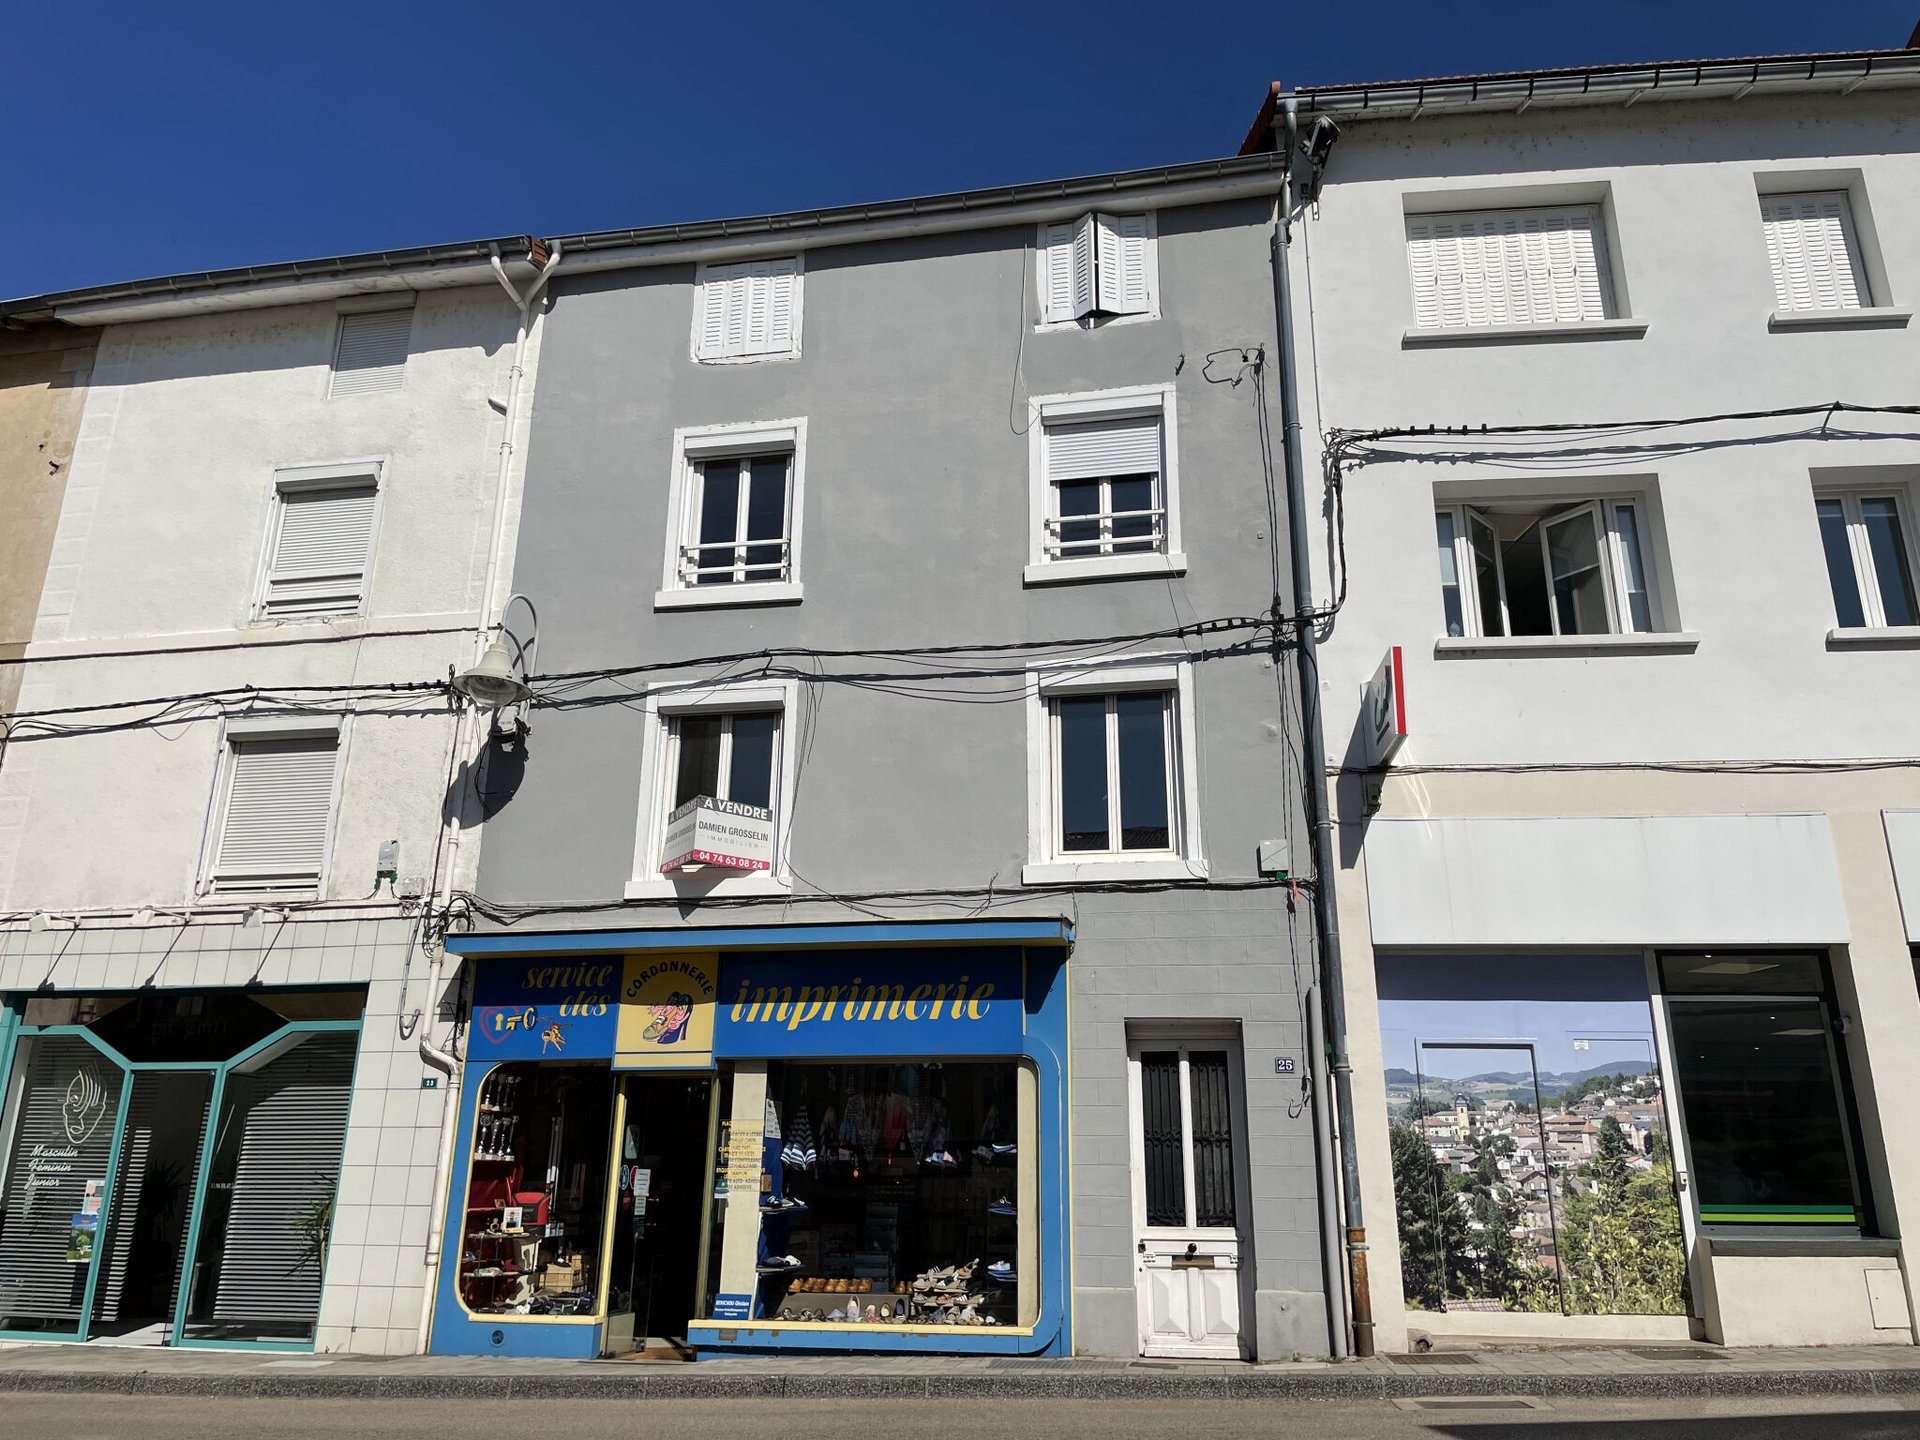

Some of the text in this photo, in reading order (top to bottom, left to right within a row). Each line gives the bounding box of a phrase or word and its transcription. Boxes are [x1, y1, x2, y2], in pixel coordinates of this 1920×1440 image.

[675, 798, 698, 819] VENDRE
[704, 797, 768, 819] A VENDRE
[698, 821, 769, 841] DAMIEN GROSSELIN
[706, 835, 759, 848] IMMOBILIER
[699, 852, 764, 869] 04 74 63 08 24
[522, 961, 613, 989] service
[625, 961, 716, 998] CORDONNERIE
[730, 975, 996, 1030] imprimerie
[1278, 1060, 1293, 1071] 25
[30, 1144, 79, 1157] Masculin
[28, 1158, 72, 1172] Féminin
[24, 1173, 60, 1190] Junior
